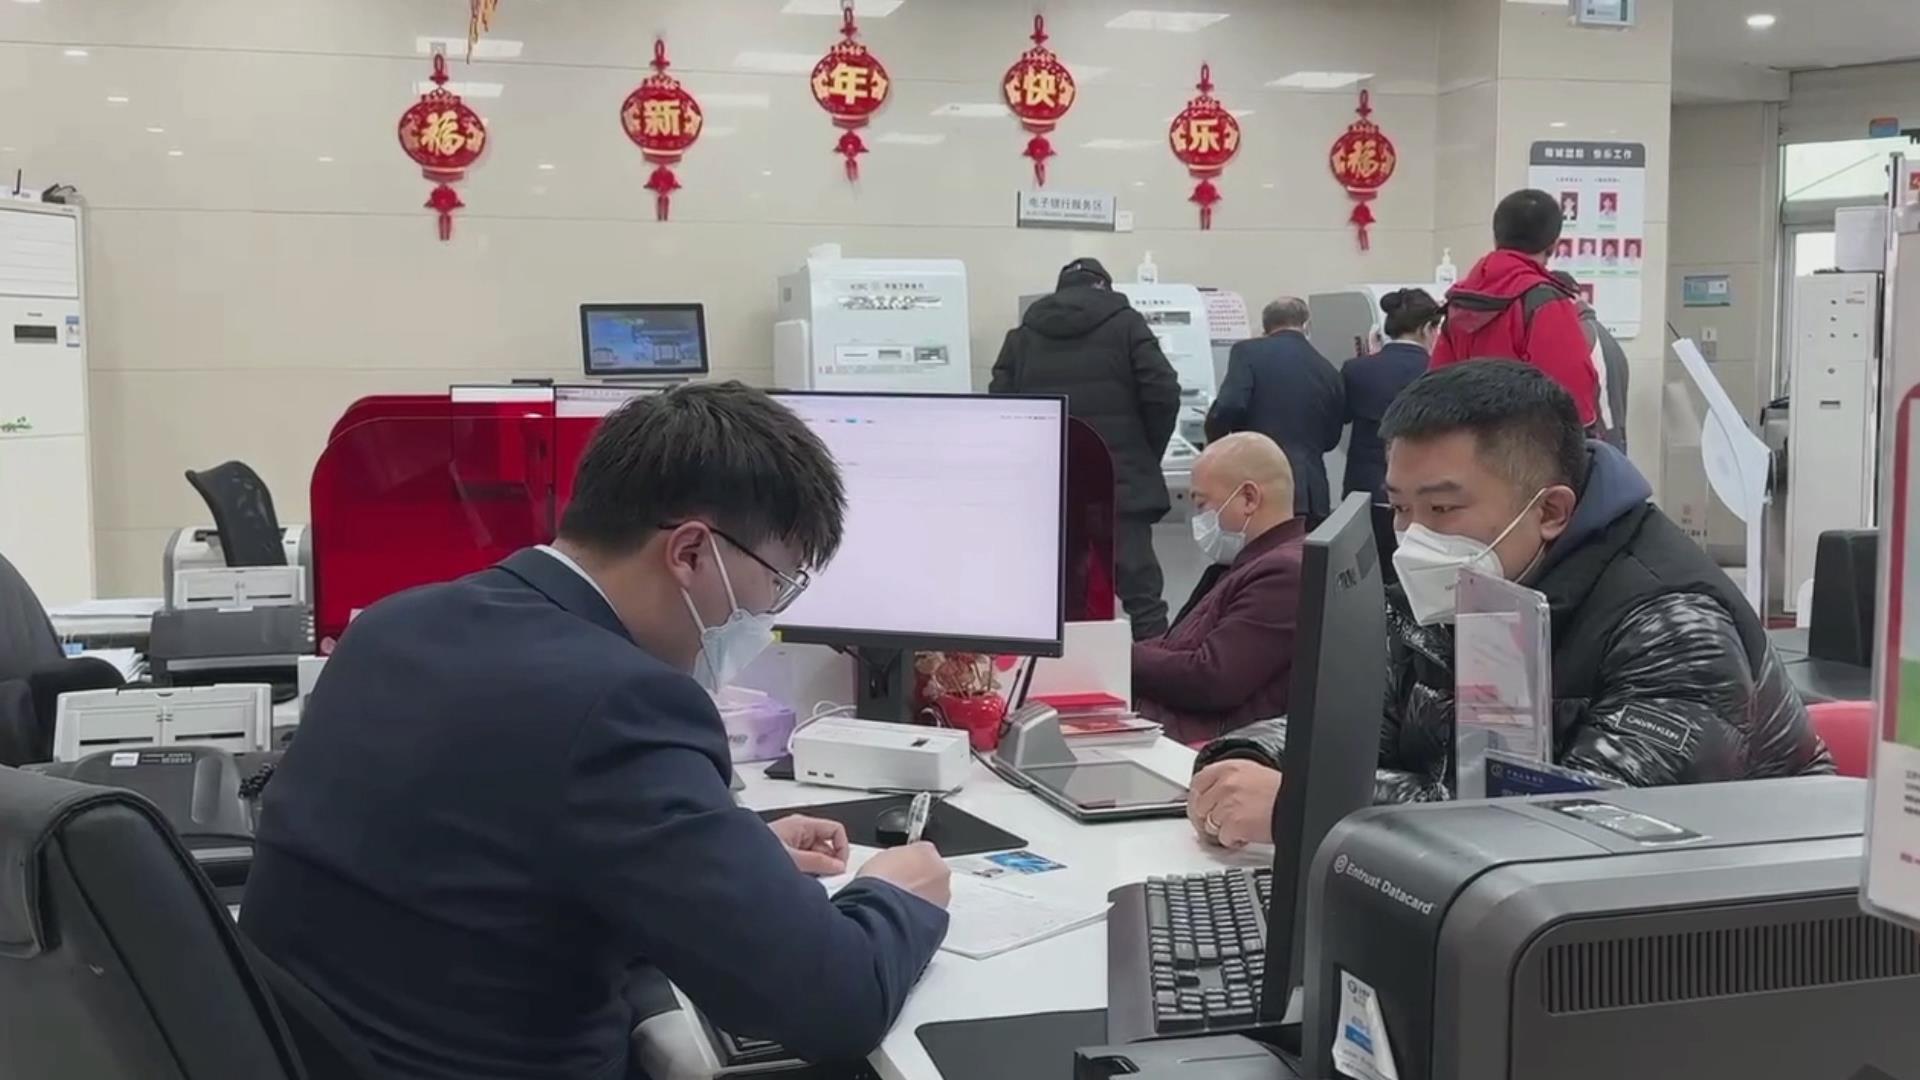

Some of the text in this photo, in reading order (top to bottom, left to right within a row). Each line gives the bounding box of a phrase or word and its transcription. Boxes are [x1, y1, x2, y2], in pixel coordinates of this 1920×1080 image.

[831, 63, 868, 104] 年
[1023, 67, 1056, 108] 快
[420, 111, 464, 156] 福
[643, 101, 681, 137] 新
[1188, 119, 1220, 153] 乐
[1348, 141, 1379, 178] 福
[1028, 196, 1104, 211] 电子银行服务区
[1346, 862, 1434, 915] Entrust Datacard
